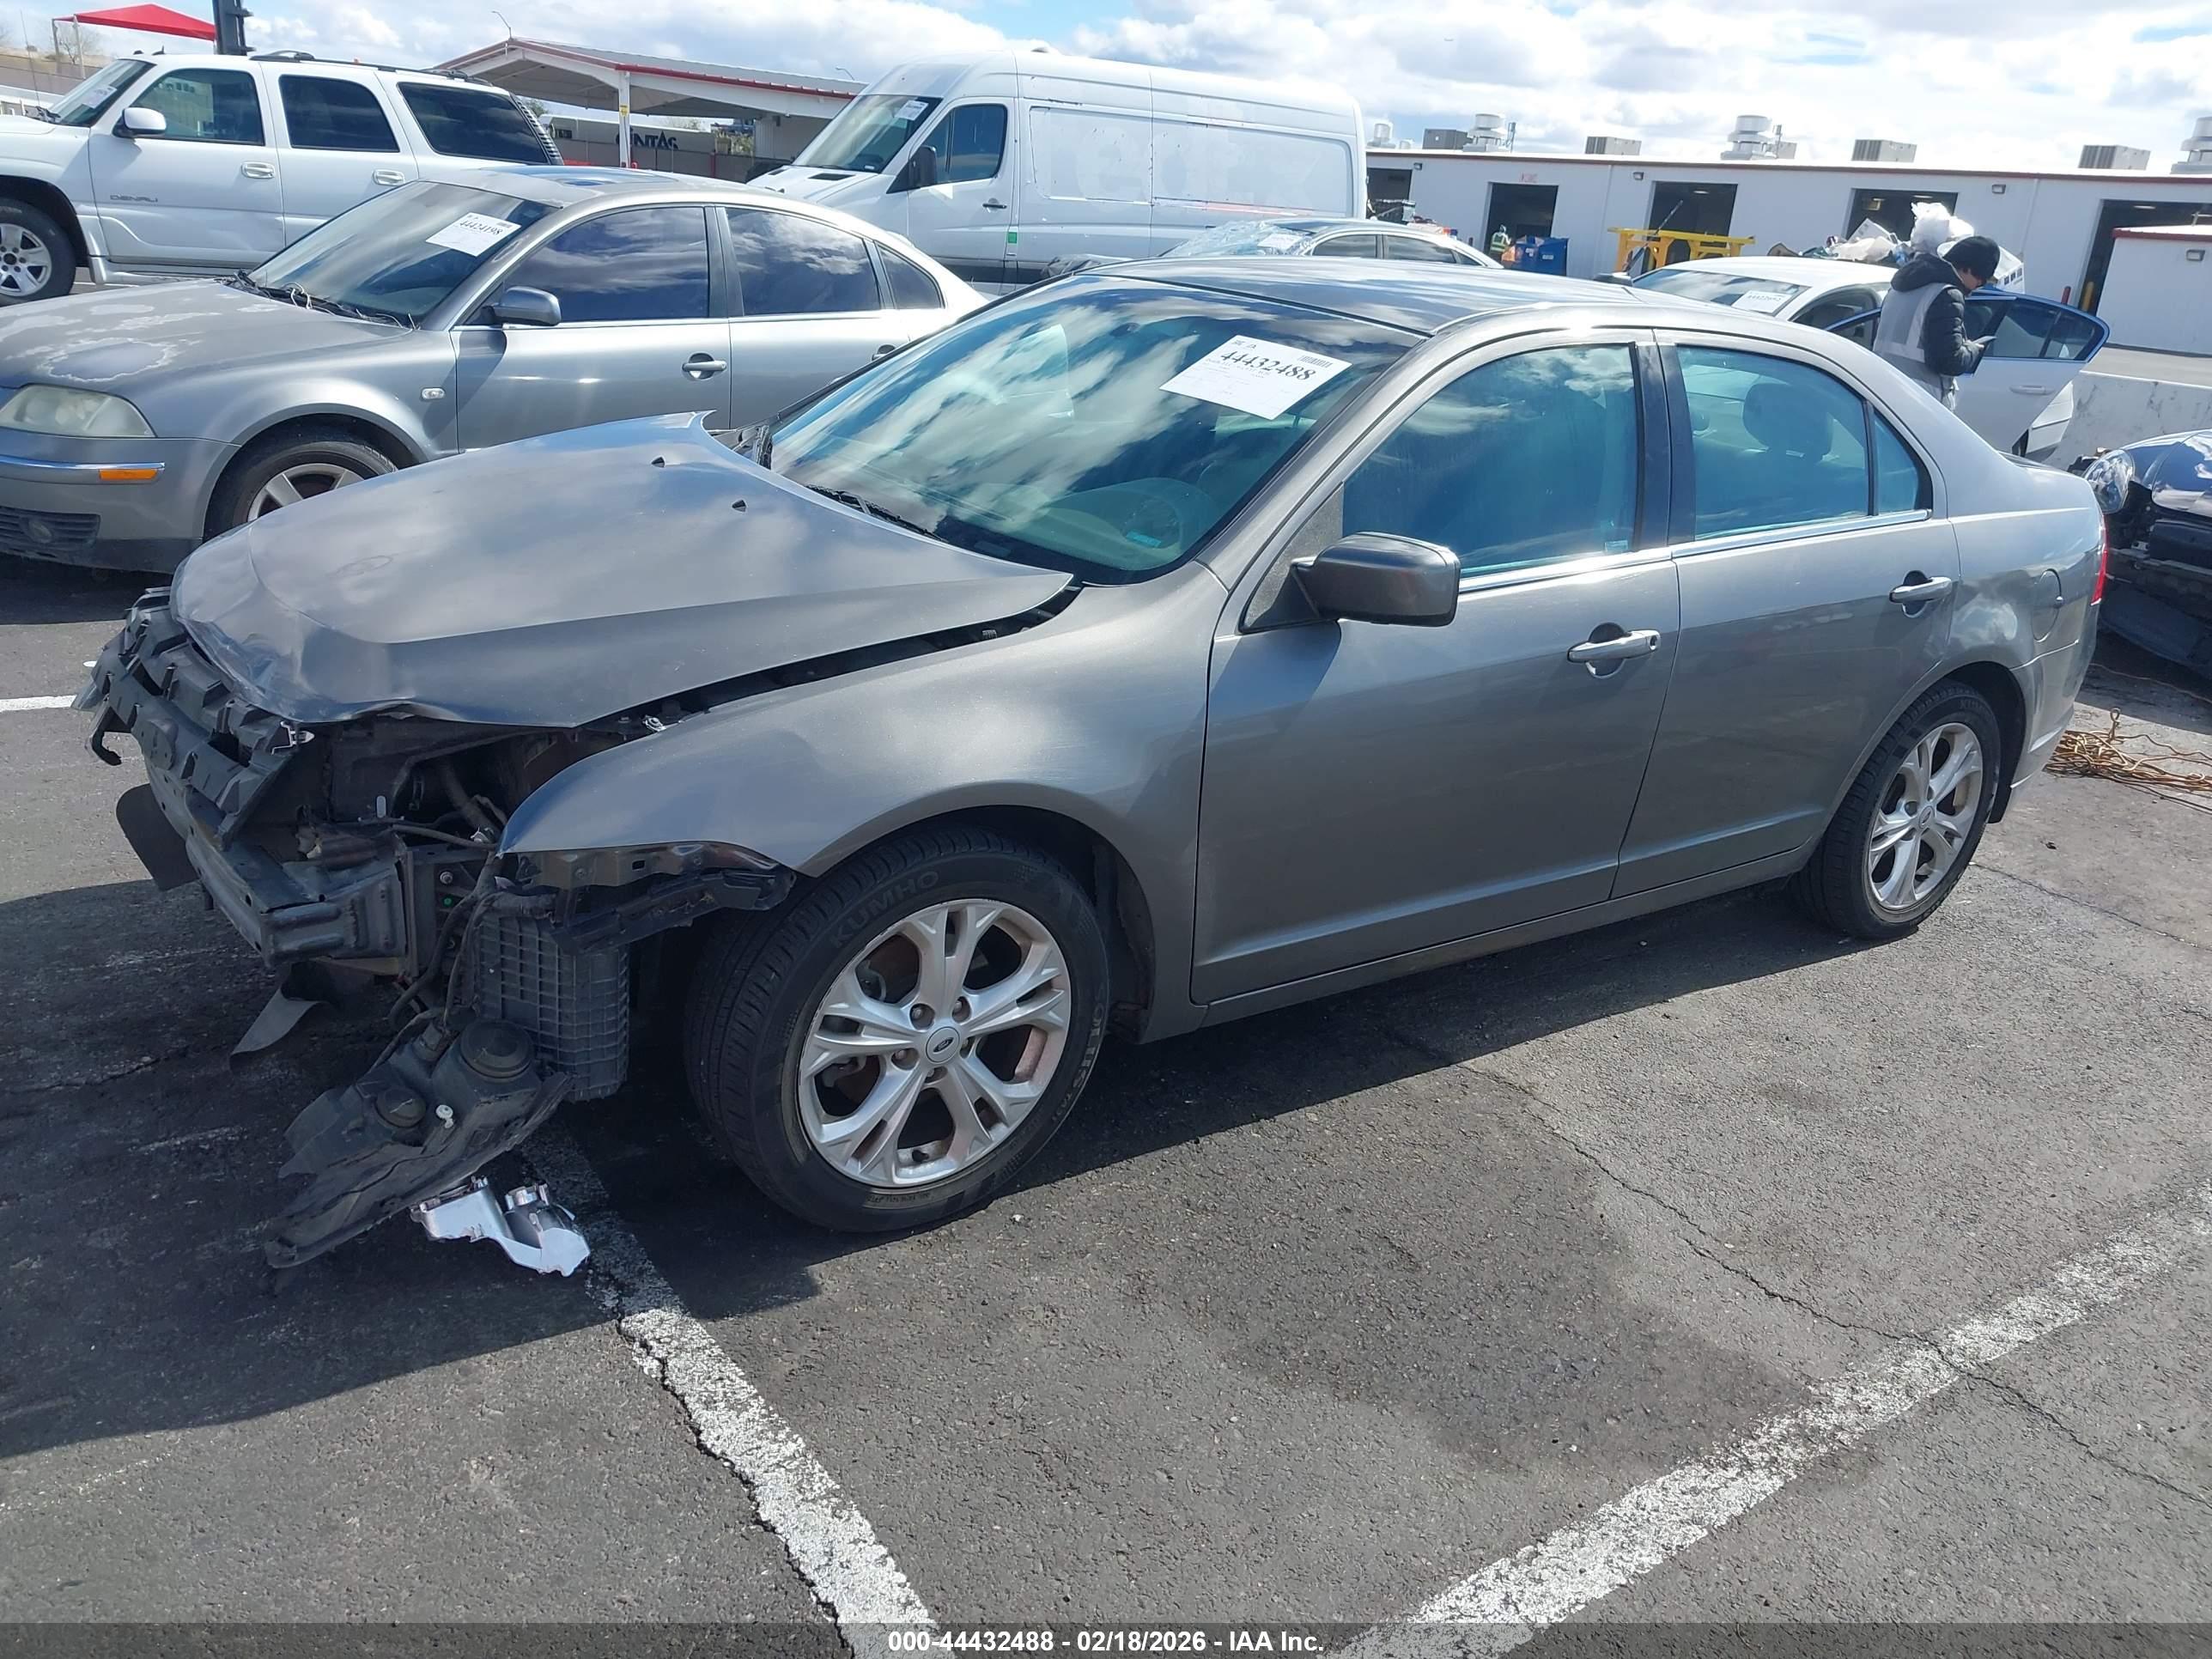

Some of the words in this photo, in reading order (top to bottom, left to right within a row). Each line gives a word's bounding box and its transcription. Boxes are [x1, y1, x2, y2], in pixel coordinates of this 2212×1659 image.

[109, 194, 158, 203] DENALI
[1220, 350, 1316, 380] 44432488
[836, 871, 939, 948] KUMHO
